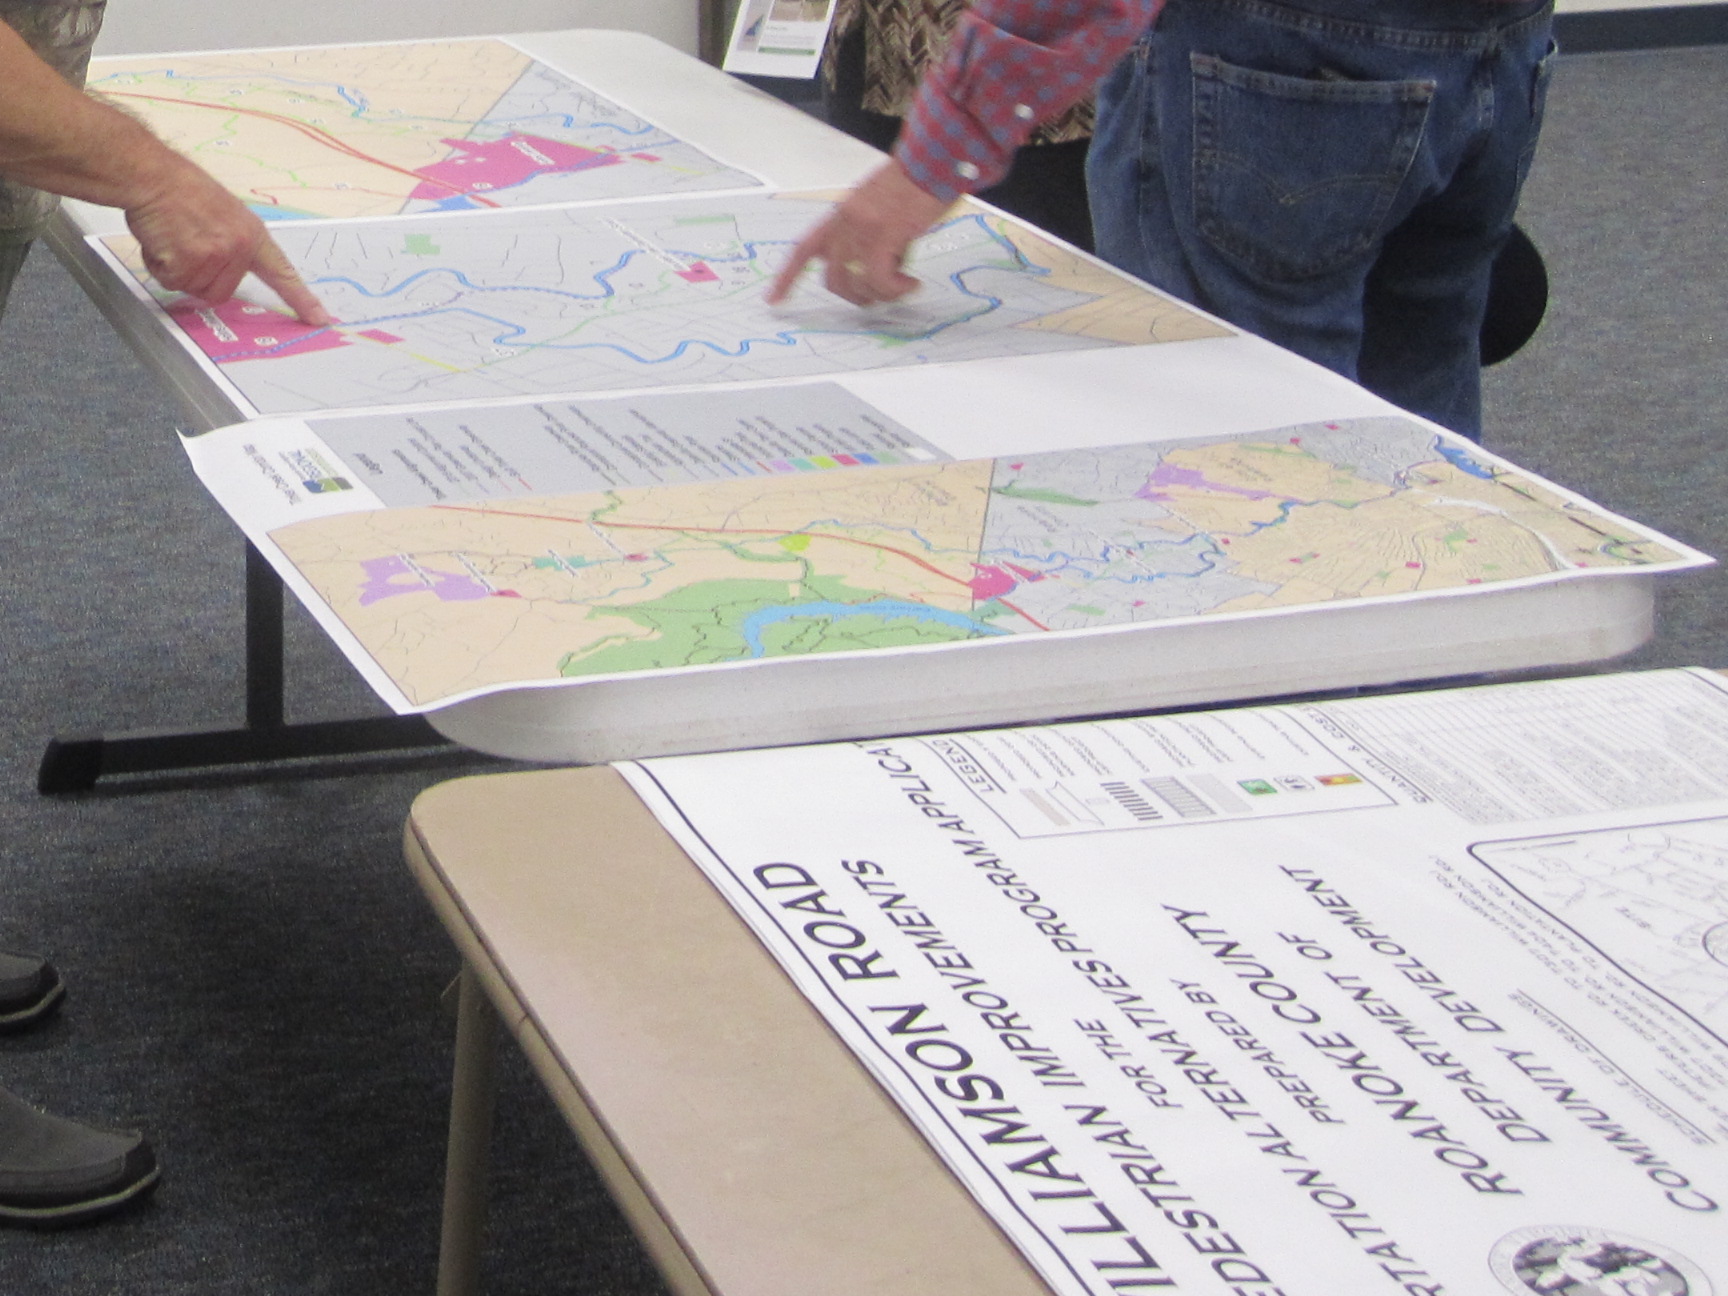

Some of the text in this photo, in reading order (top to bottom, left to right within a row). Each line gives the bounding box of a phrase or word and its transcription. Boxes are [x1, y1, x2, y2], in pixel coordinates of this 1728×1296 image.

[933, 739, 994, 792] LEGEND
[842, 861, 1084, 1086] IMPROVEMENTS
[953, 840, 1092, 952] PROGRAM
[753, 863, 1178, 1296] ILLIAMSON ROAD
[1073, 960, 1305, 1159] ALTERNATIVES
[1075, 1020, 1181, 1107] FOR THE
[1163, 906, 1522, 1194] ROANOKE COUNTY
[1169, 978, 1343, 1123] PREPARED BY
[1274, 929, 1550, 1142] DEPARTMENT OF
[1280, 866, 1719, 1212] COMMUNITY DEVELOPMENT
[1508, 991, 1709, 1146] SCHEDULE OF DRAWINGS
